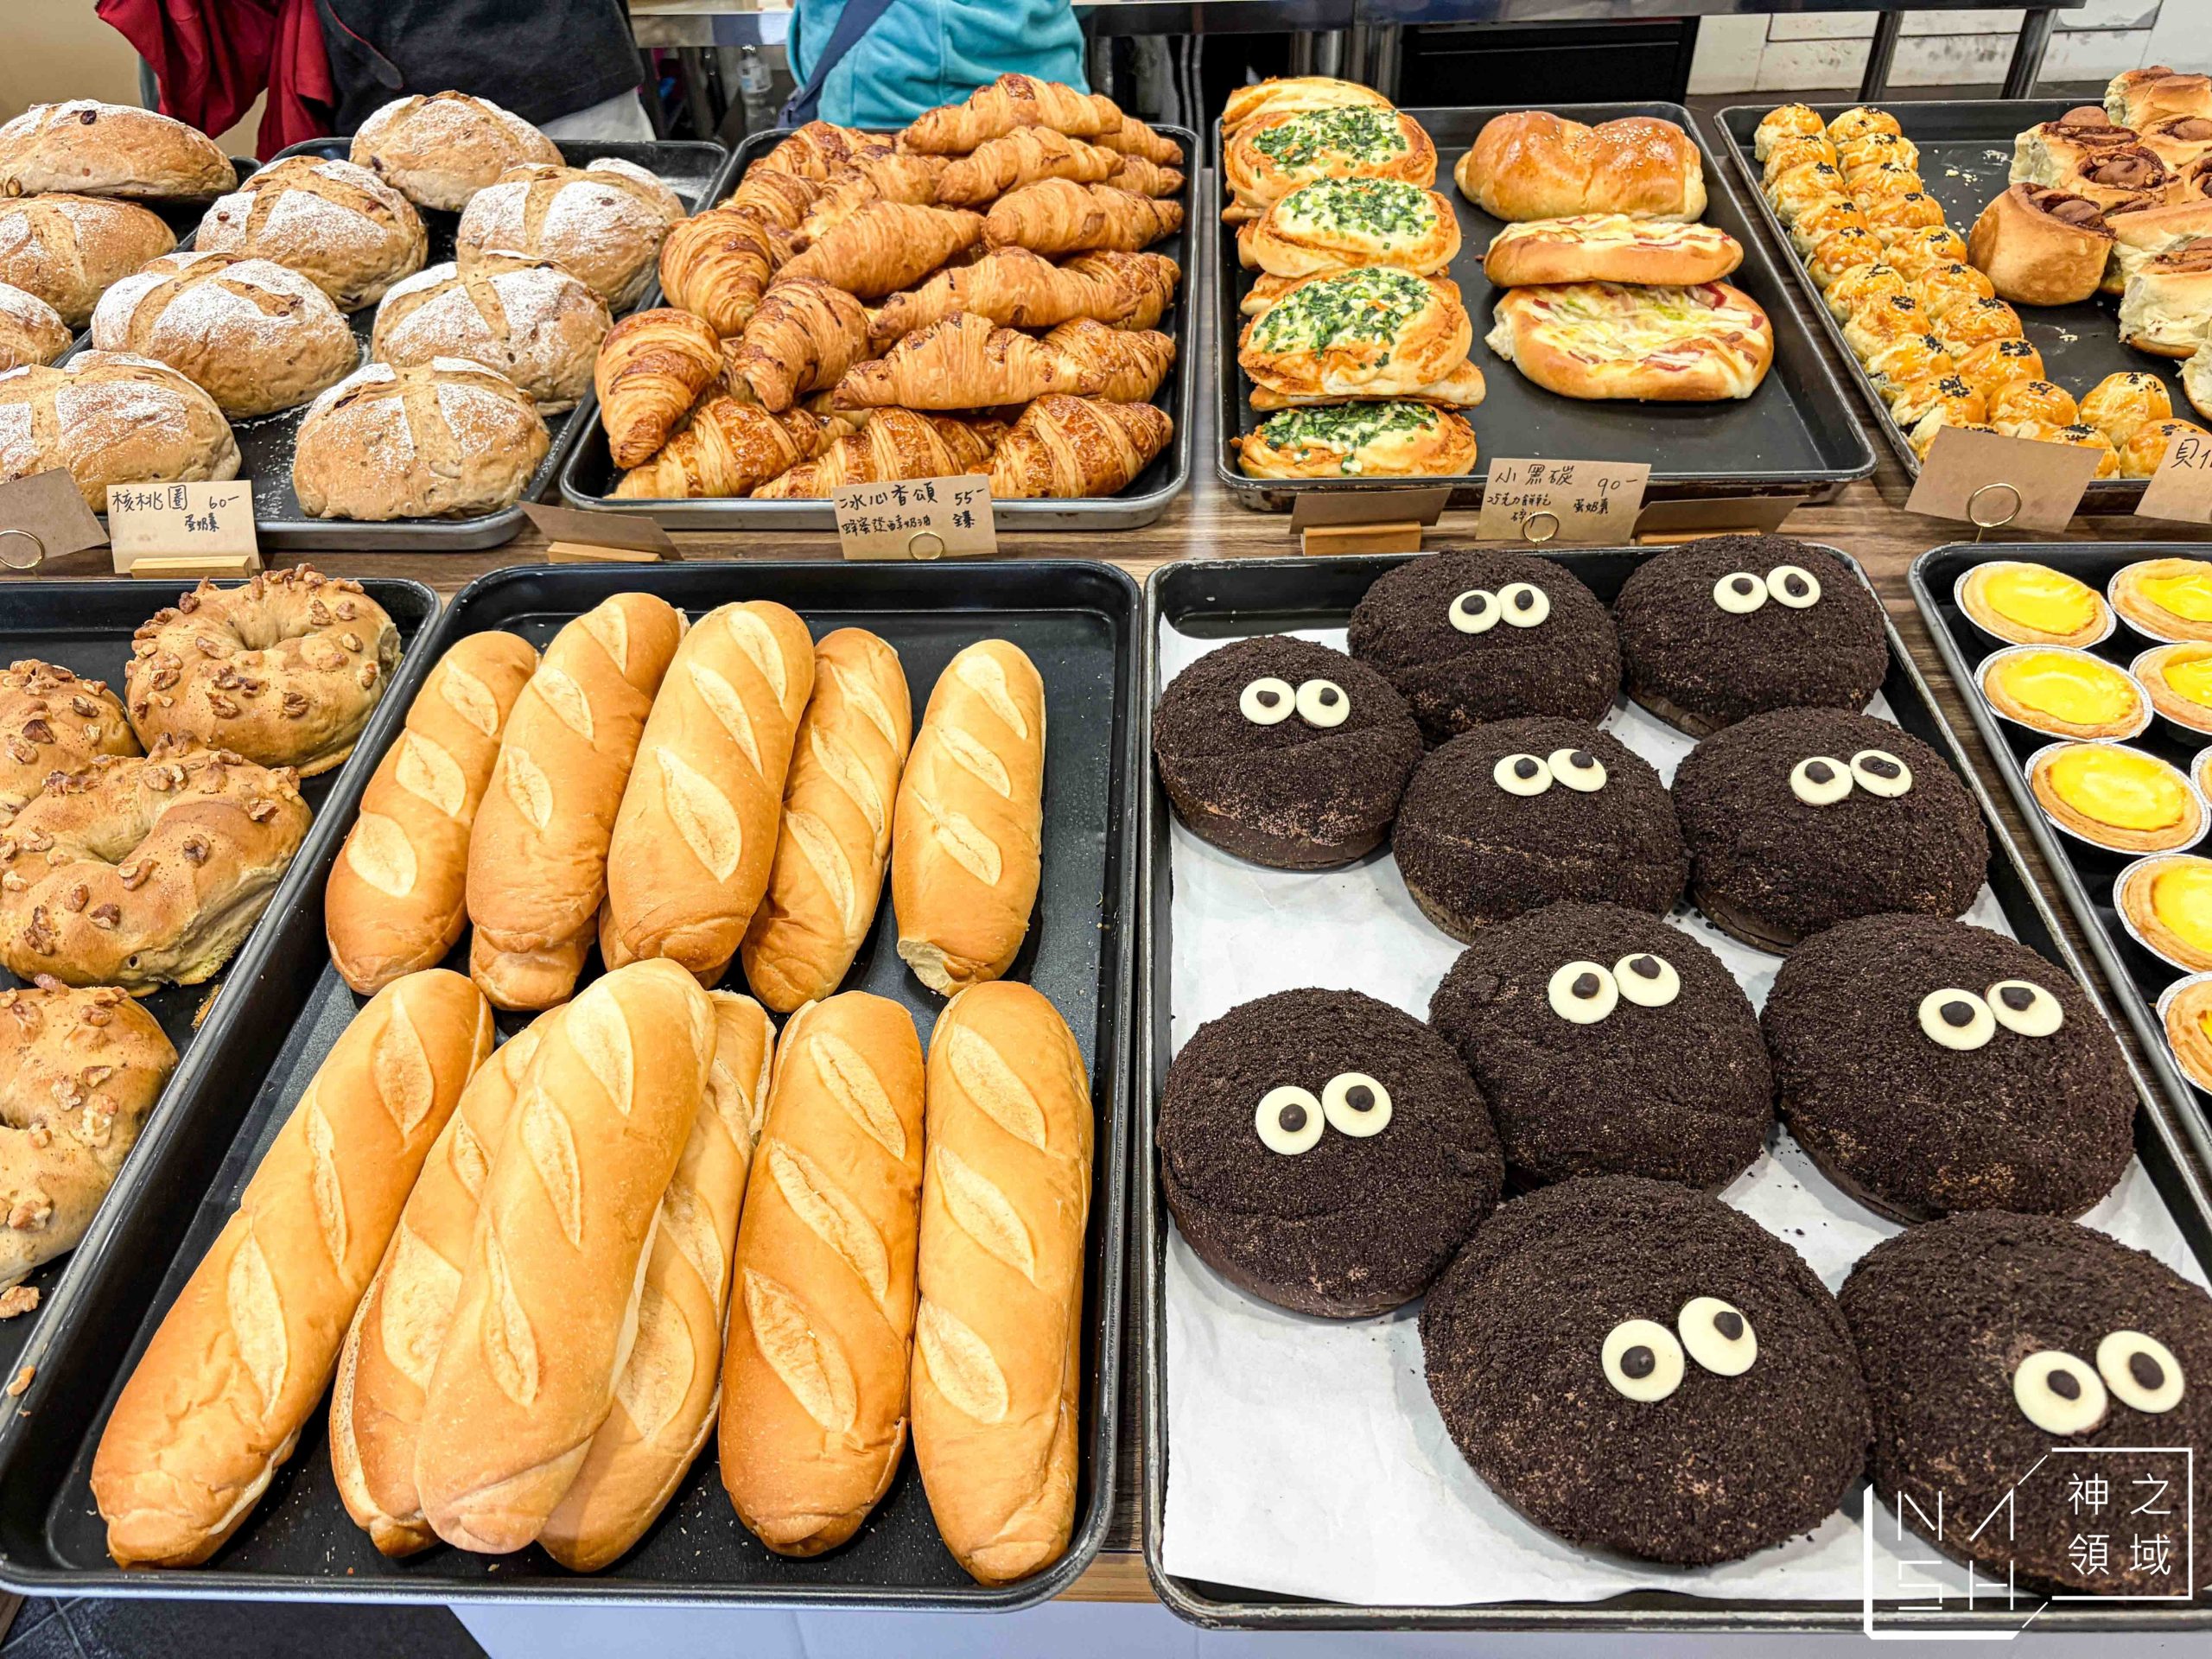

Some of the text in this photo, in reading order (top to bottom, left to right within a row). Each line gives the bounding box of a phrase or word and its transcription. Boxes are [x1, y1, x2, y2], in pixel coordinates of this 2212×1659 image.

[2171, 438, 2212, 469] 貝
[111, 485, 188, 512] 核桃圈
